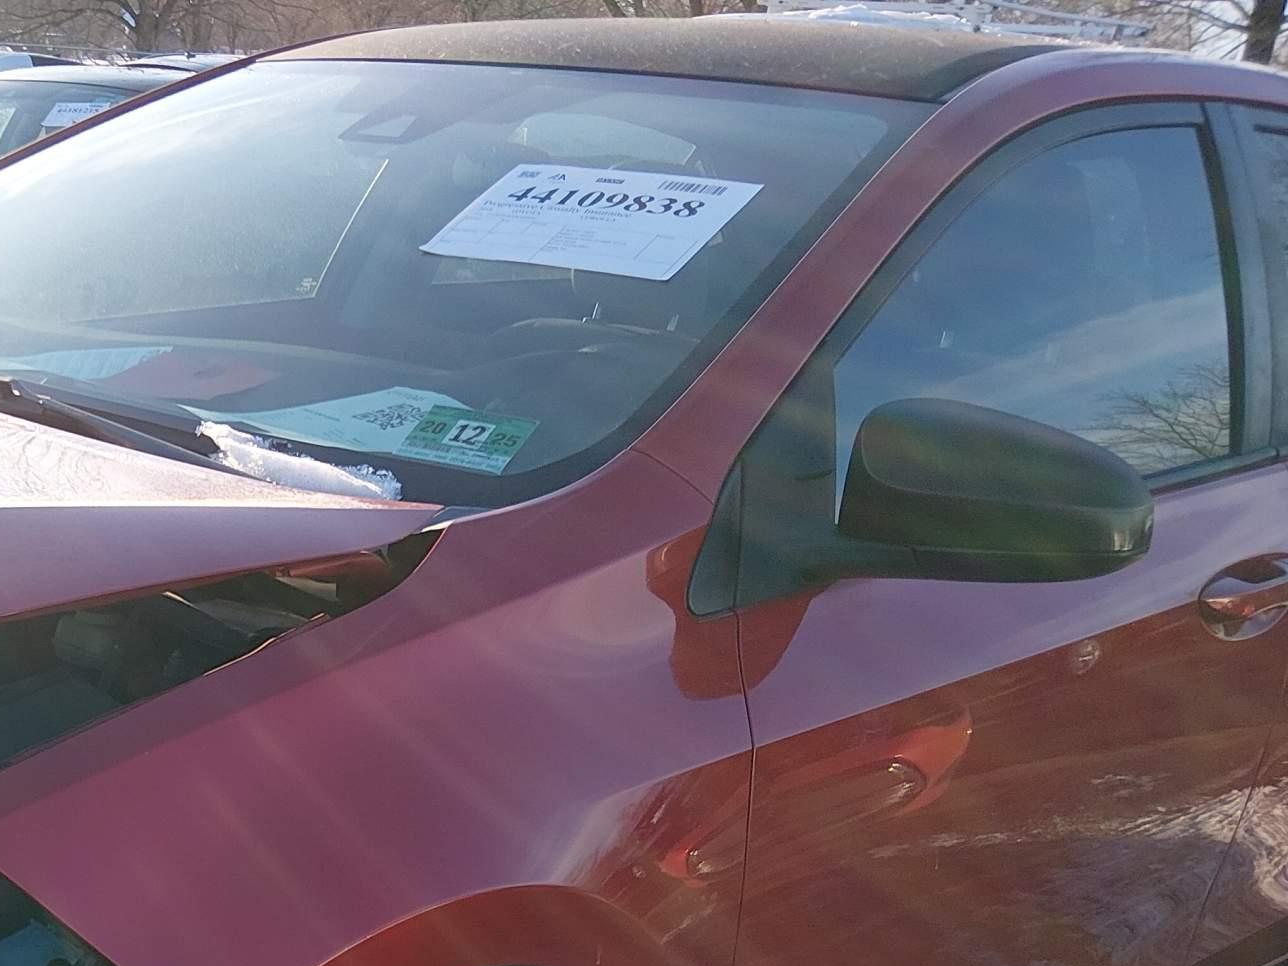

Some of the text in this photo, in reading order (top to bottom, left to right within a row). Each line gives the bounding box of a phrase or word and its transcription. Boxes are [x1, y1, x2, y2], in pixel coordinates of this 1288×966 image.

[508, 185, 705, 218] 44109838
[420, 420, 521, 448] 20 12 25
